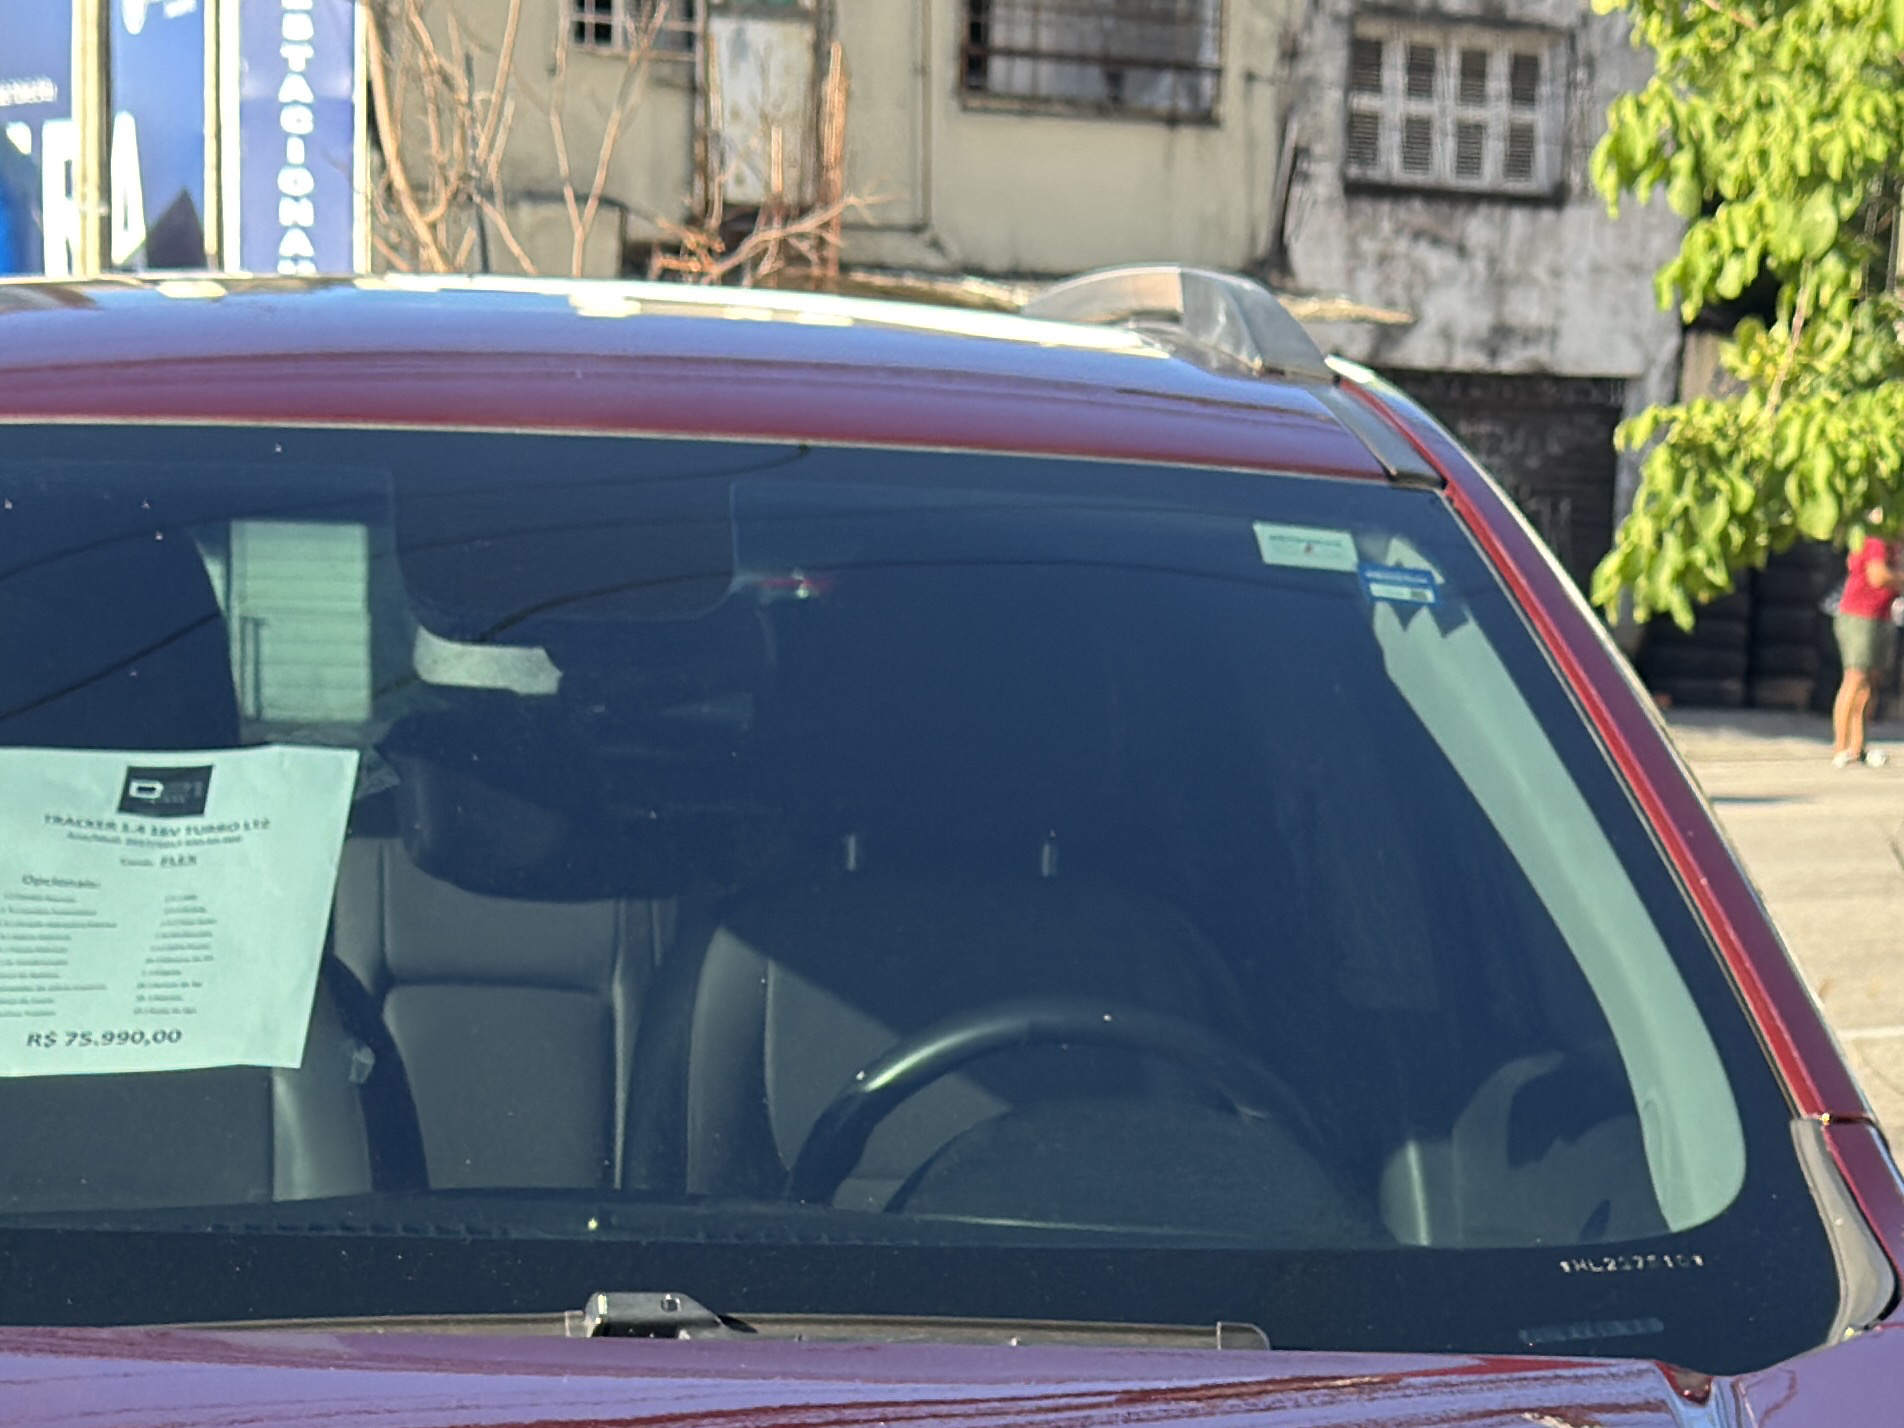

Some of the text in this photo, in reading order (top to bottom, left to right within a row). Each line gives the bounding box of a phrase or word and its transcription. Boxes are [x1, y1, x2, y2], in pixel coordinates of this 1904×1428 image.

[44, 815, 117, 832] TRACKER
[26, 1028, 183, 1048] R$ 75.990,00
